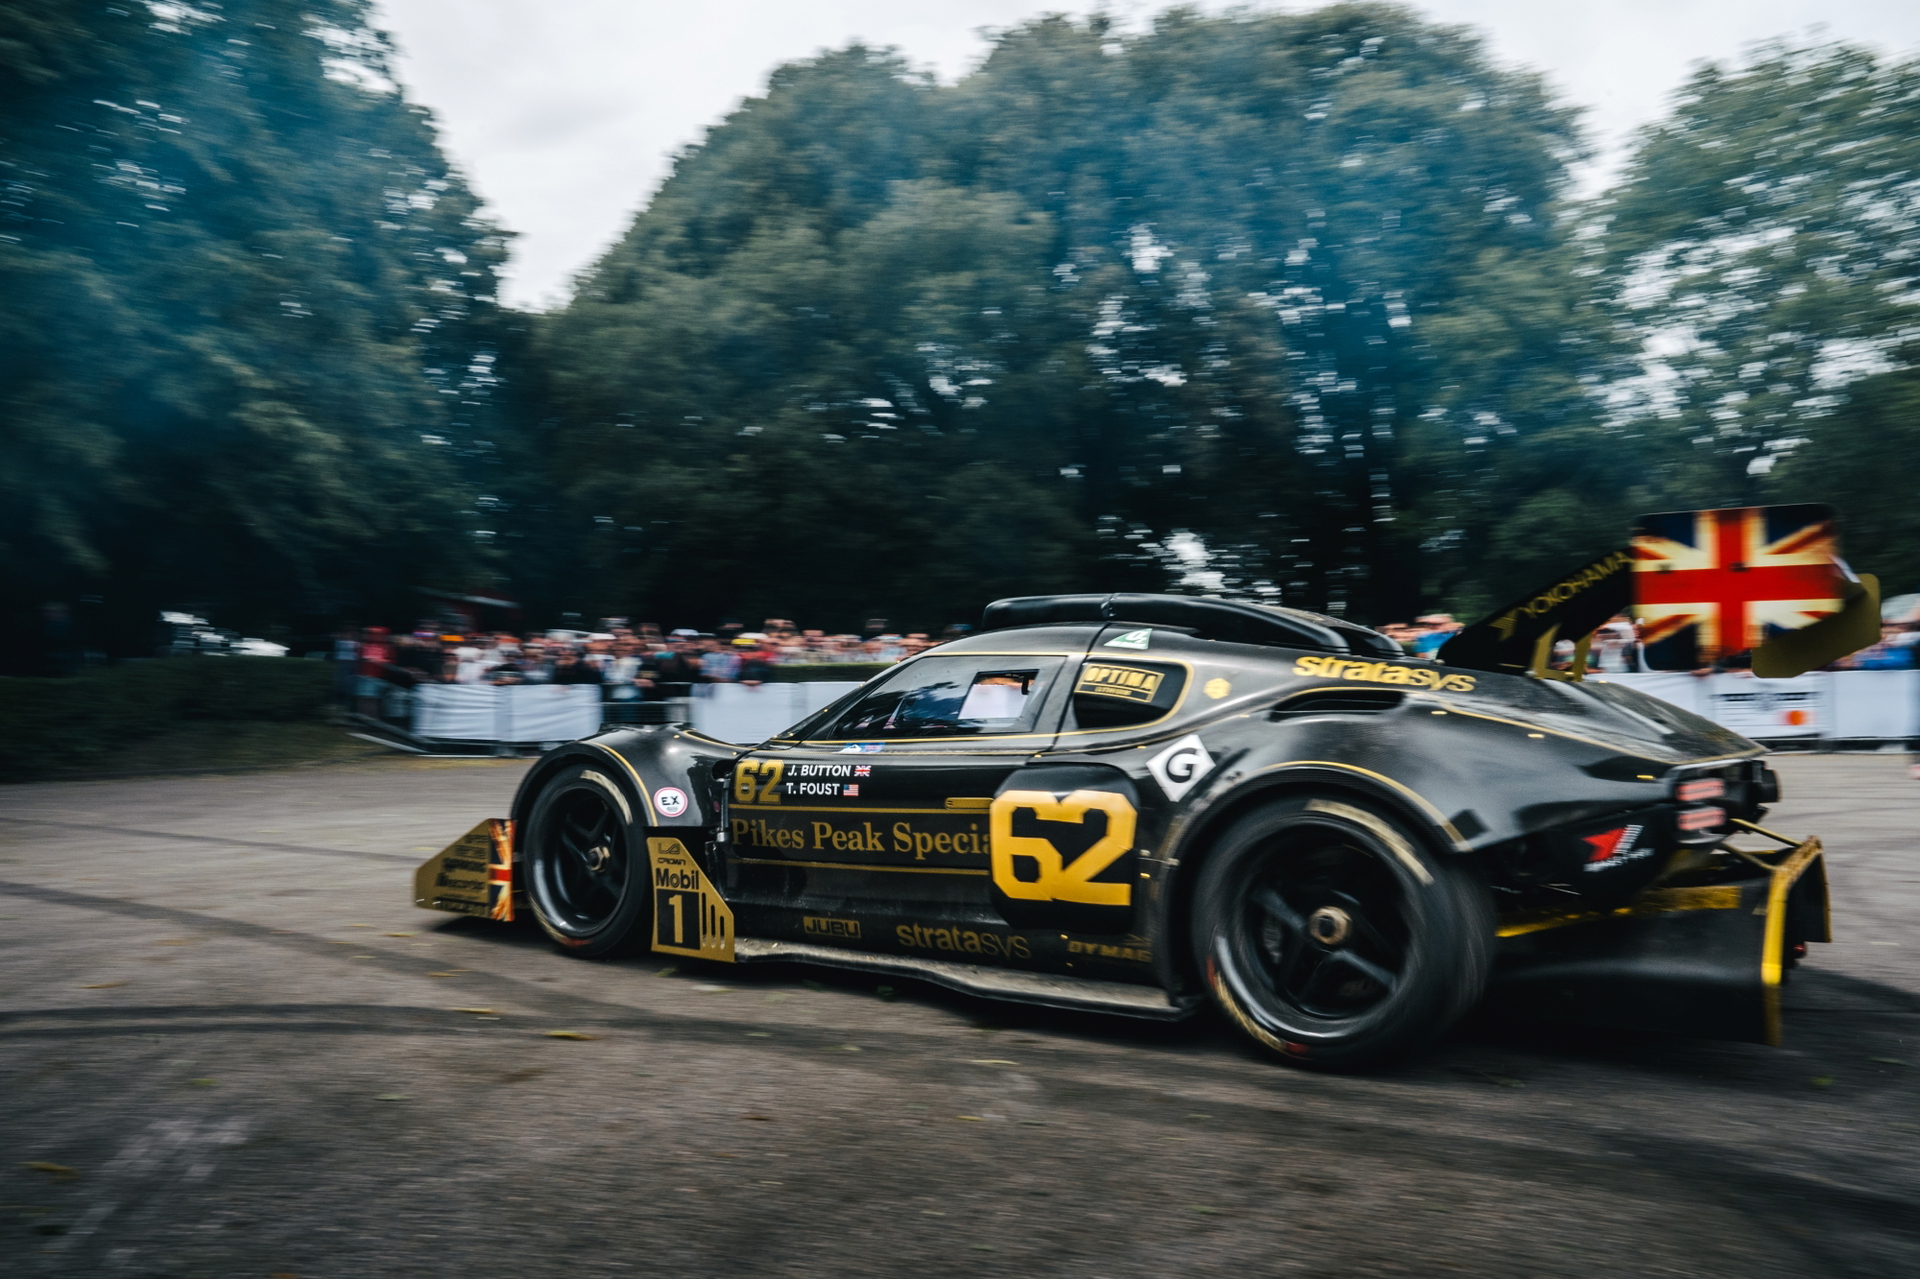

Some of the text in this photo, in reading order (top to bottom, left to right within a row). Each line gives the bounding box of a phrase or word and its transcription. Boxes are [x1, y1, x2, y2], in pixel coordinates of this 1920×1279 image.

[1517, 551, 1636, 618] YOKOHAMA
[1083, 667, 1158, 691] OPTIMA
[1292, 656, 1477, 692] stratasys
[734, 759, 785, 804] 62
[787, 765, 851, 777] J. BUTTON
[1166, 747, 1197, 784] G
[661, 795, 680, 806] EX
[786, 783, 840, 796] T. FOUST
[730, 818, 804, 850] Pikes
[812, 822, 885, 852] Peak
[990, 790, 1138, 906] 62
[656, 868, 699, 890] Mobil
[668, 894, 684, 944] 1
[896, 922, 1032, 958] stratasys
